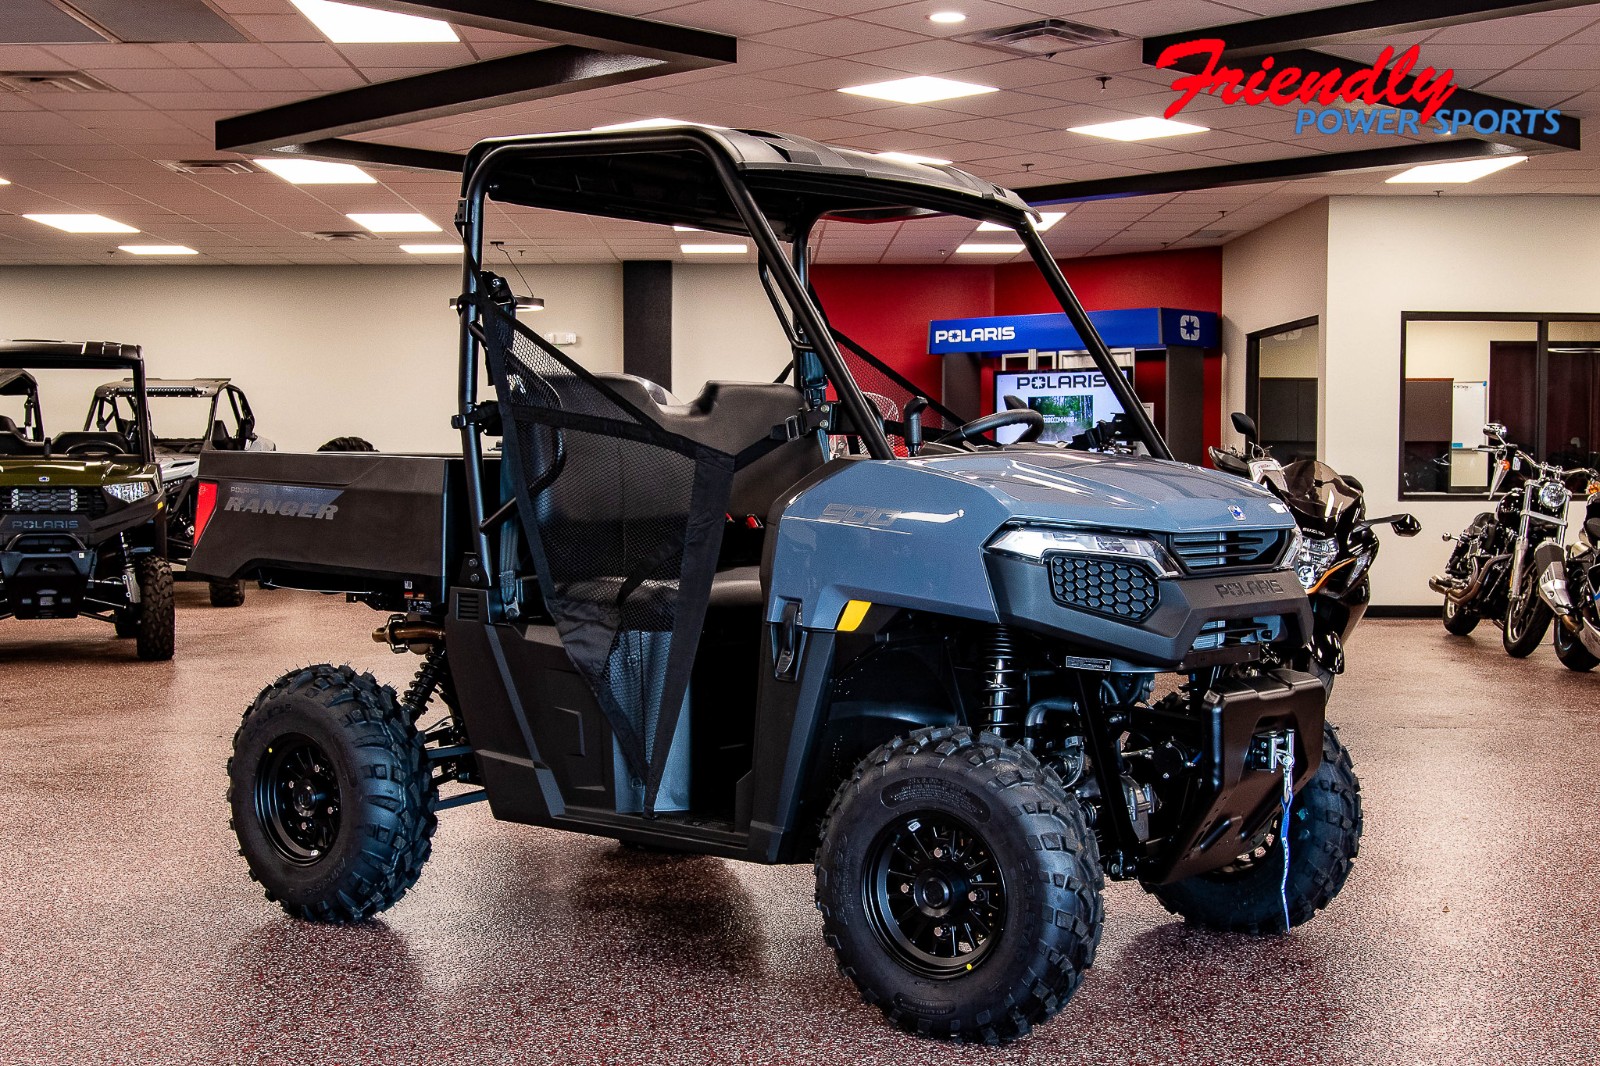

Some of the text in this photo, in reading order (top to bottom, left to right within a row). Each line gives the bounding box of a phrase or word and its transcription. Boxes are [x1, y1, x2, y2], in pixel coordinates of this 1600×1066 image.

[935, 326, 1016, 344] POLARIS
[1016, 374, 1107, 390] POLARIS
[224, 496, 339, 520] RANGER
[12, 520, 79, 529] POLARIS
[1214, 579, 1284, 599] POLARIS
